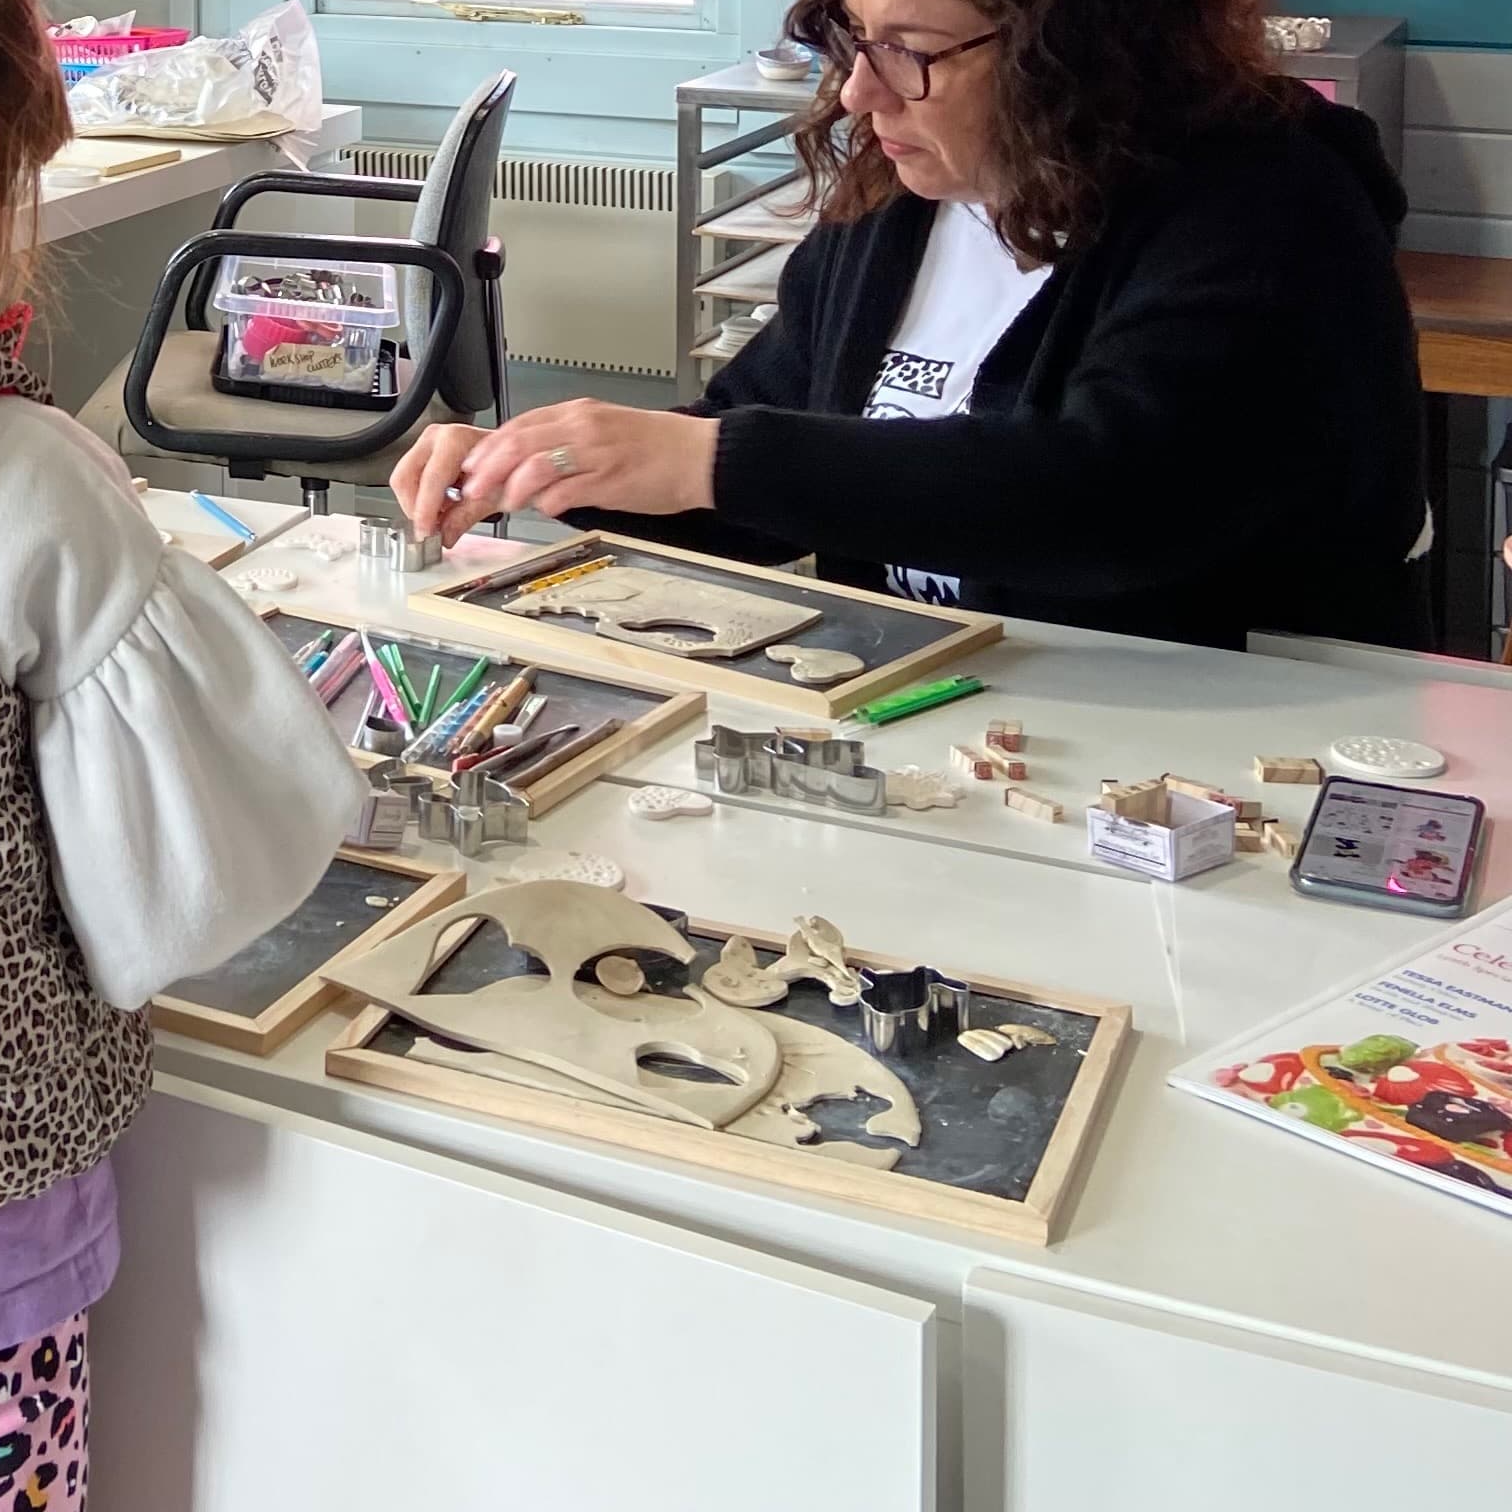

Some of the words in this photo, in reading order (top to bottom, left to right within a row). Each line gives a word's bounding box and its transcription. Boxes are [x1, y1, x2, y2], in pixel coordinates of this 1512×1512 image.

[1402, 969, 1442, 987] TESSA
[1354, 992, 1397, 1010] LOTTE
[1399, 1008, 1440, 1025] GLOB
[1377, 980, 1435, 1004] FENELLA
[1438, 1001, 1477, 1019] ELMS
